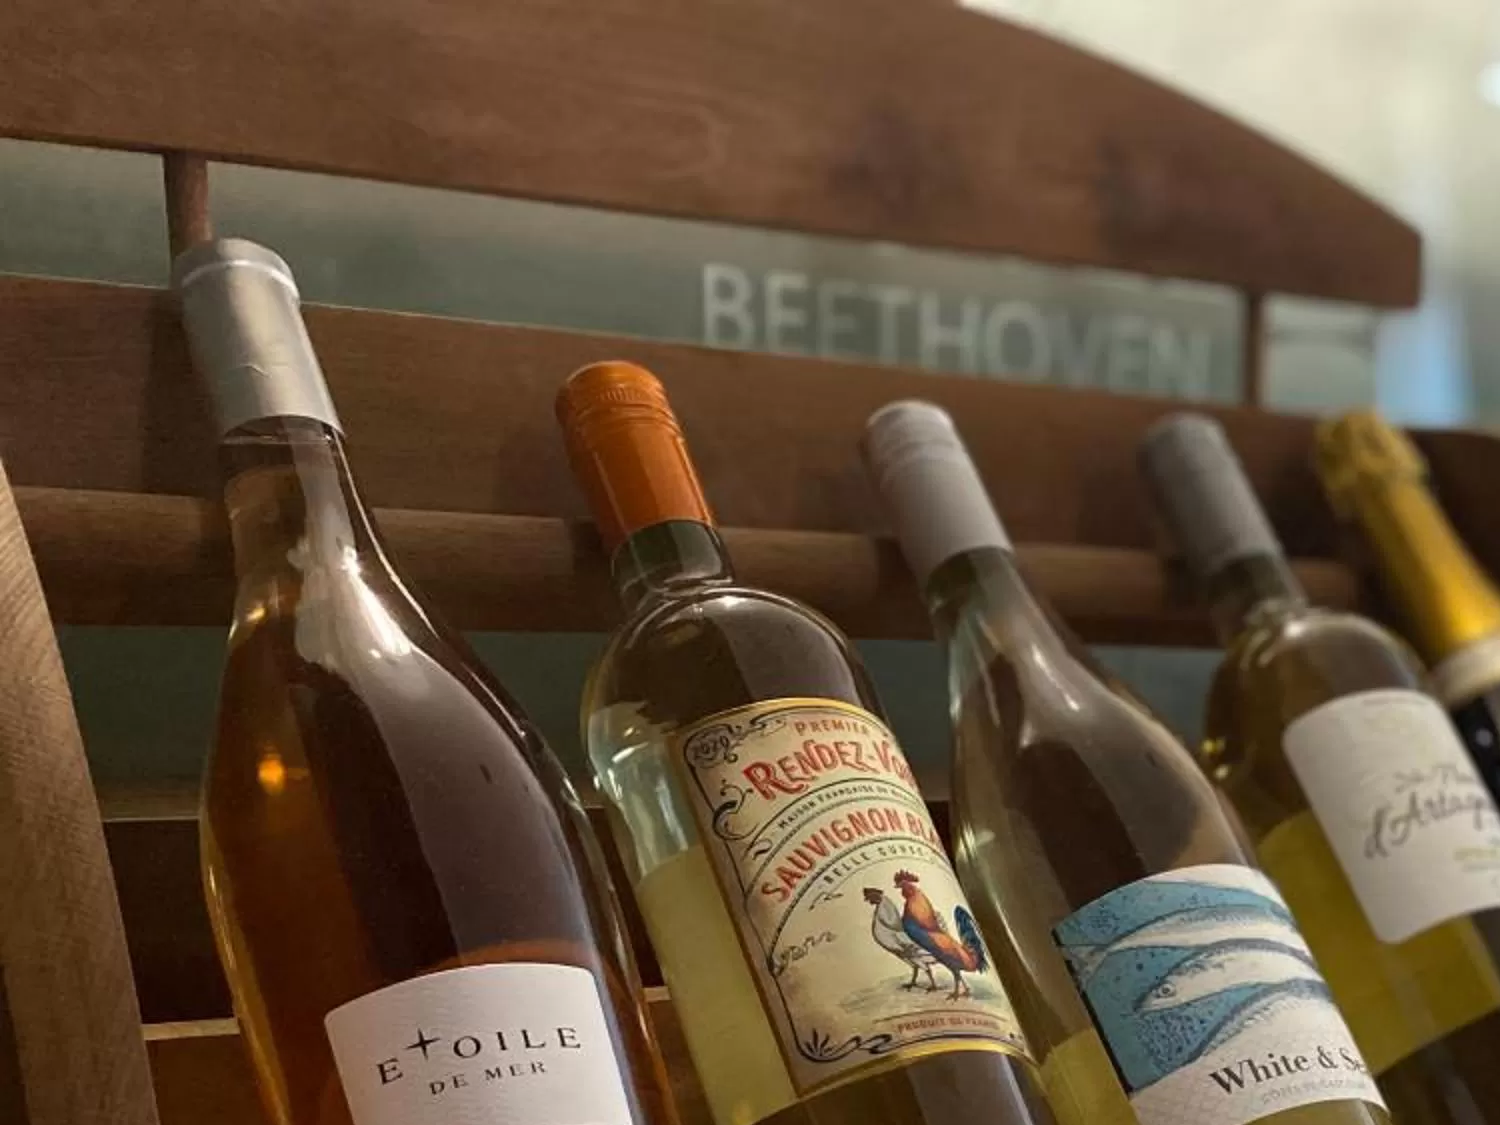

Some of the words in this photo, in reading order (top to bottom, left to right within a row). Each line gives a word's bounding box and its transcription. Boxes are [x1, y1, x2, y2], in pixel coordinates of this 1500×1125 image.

[703, 263, 1213, 400] BEETHOVEN
[761, 807, 905, 901] SAUVIGNON
[823, 851, 871, 884] BELLE
[430, 1075, 469, 1096] DE
[485, 1060, 547, 1081] MER
[1208, 1052, 1310, 1095] White
[1316, 1045, 1338, 1069] &
